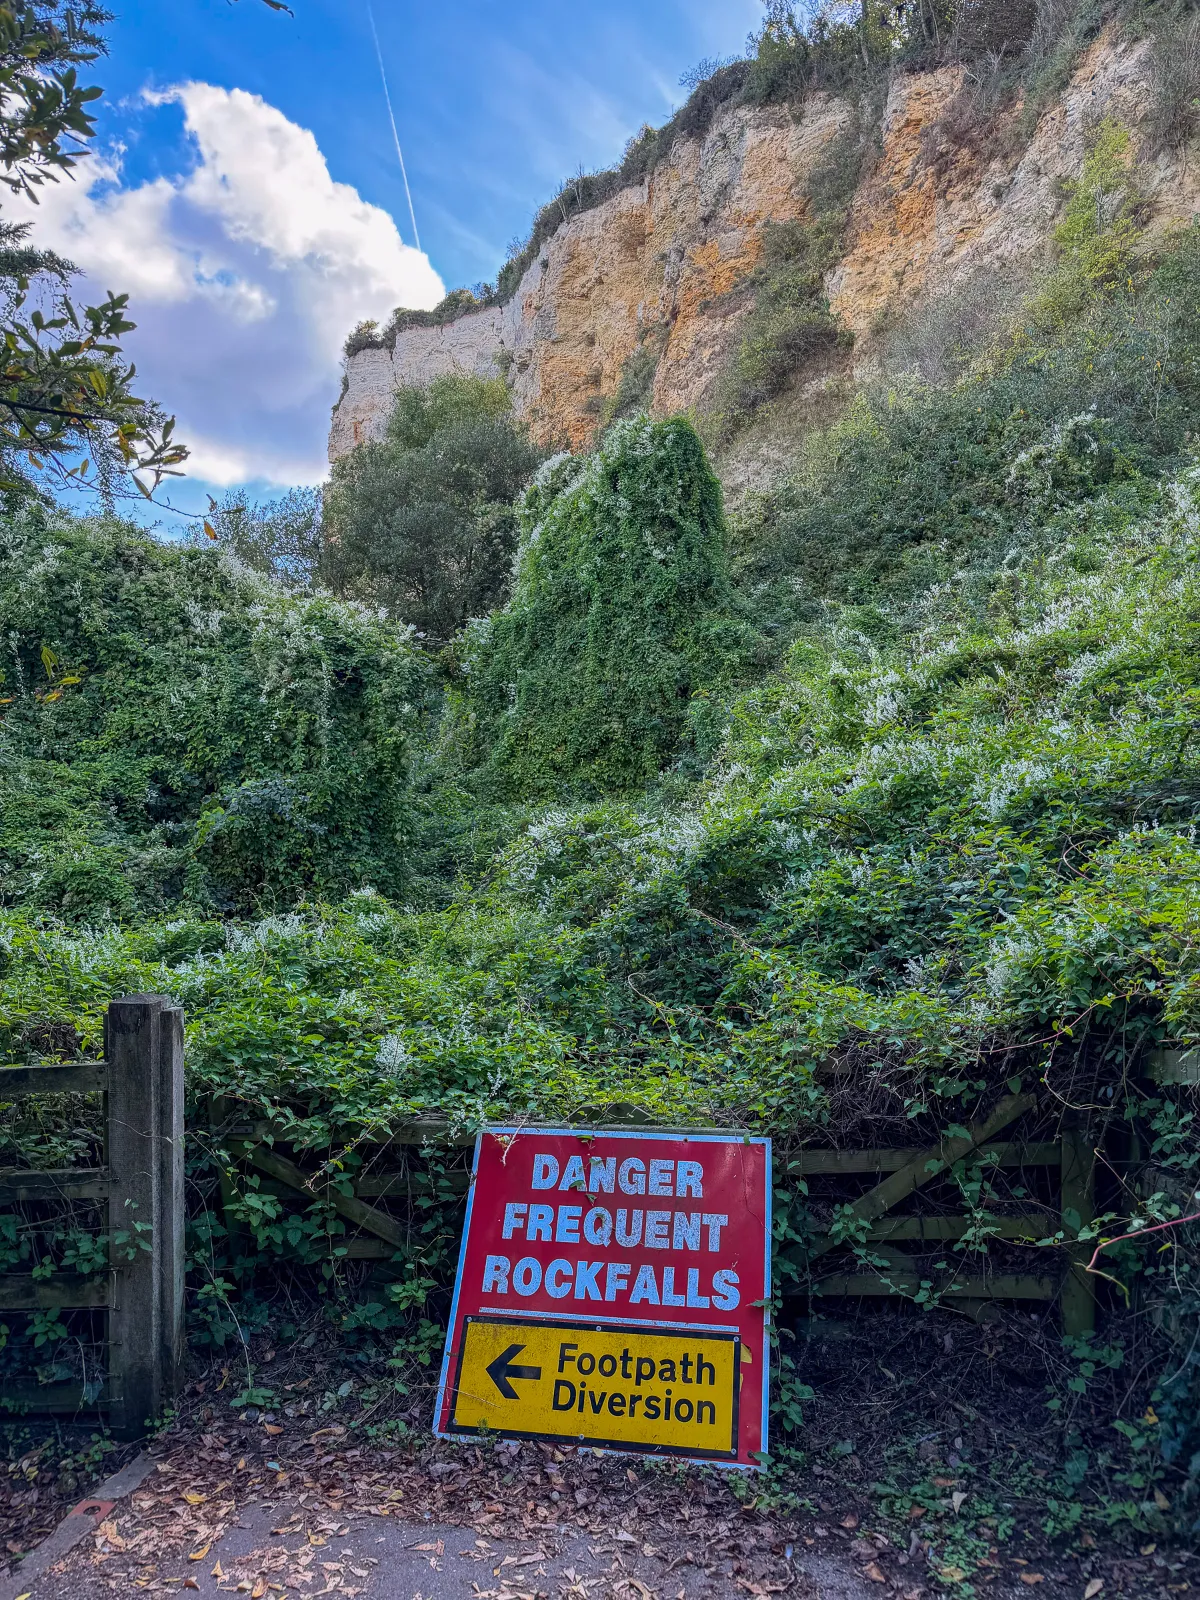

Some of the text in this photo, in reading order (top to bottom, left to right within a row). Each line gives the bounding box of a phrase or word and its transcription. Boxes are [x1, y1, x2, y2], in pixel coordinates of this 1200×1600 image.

[531, 1153, 704, 1198] DANGER
[501, 1202, 729, 1252] FREQUENT
[481, 1255, 741, 1311] ROCKFALLS
[557, 1343, 716, 1385] Footpath
[551, 1379, 716, 1425] Diversion
